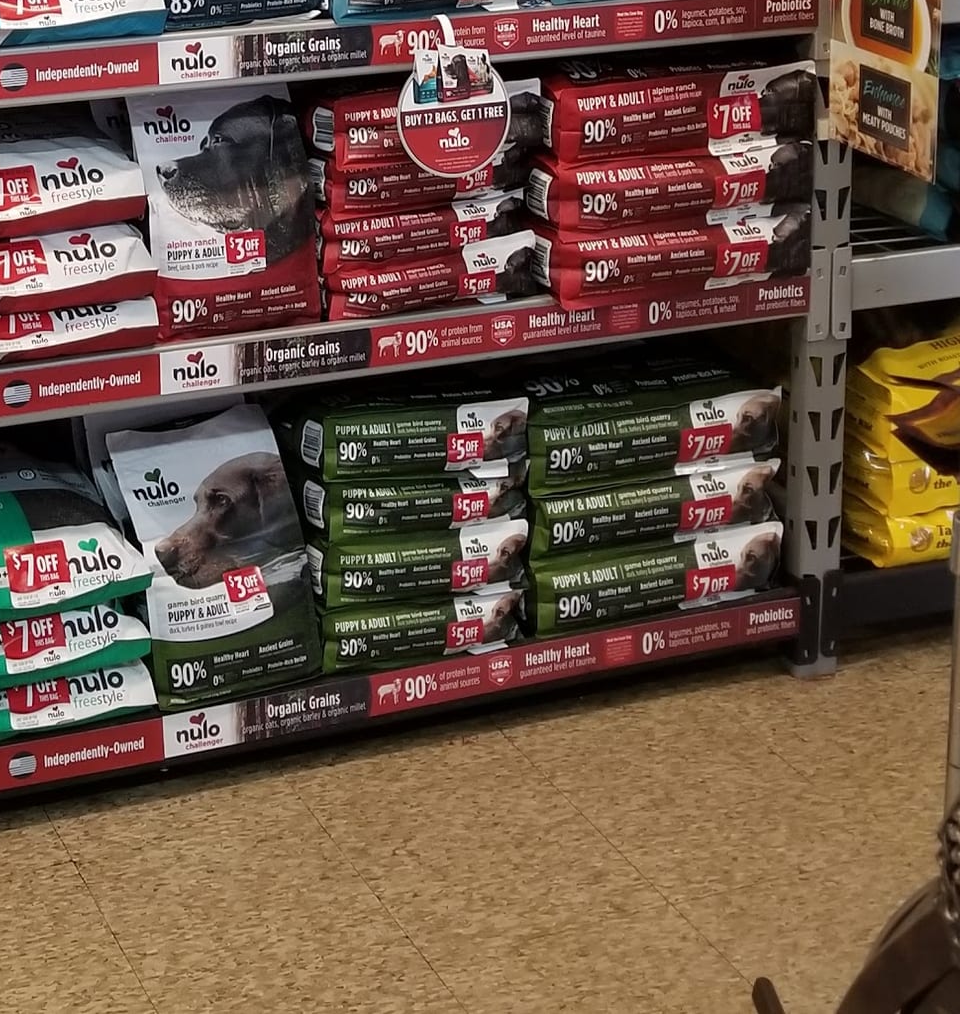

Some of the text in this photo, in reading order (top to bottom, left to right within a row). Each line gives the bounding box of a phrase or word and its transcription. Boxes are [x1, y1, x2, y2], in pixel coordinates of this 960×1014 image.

[172, 299, 208, 323] 90%
[452, 439, 478, 458] $5 OFF
[168, 594, 226, 609] game bird quarry
[750, 608, 793, 624] Probiotics
[44, 738, 144, 768] Independently-Owned
